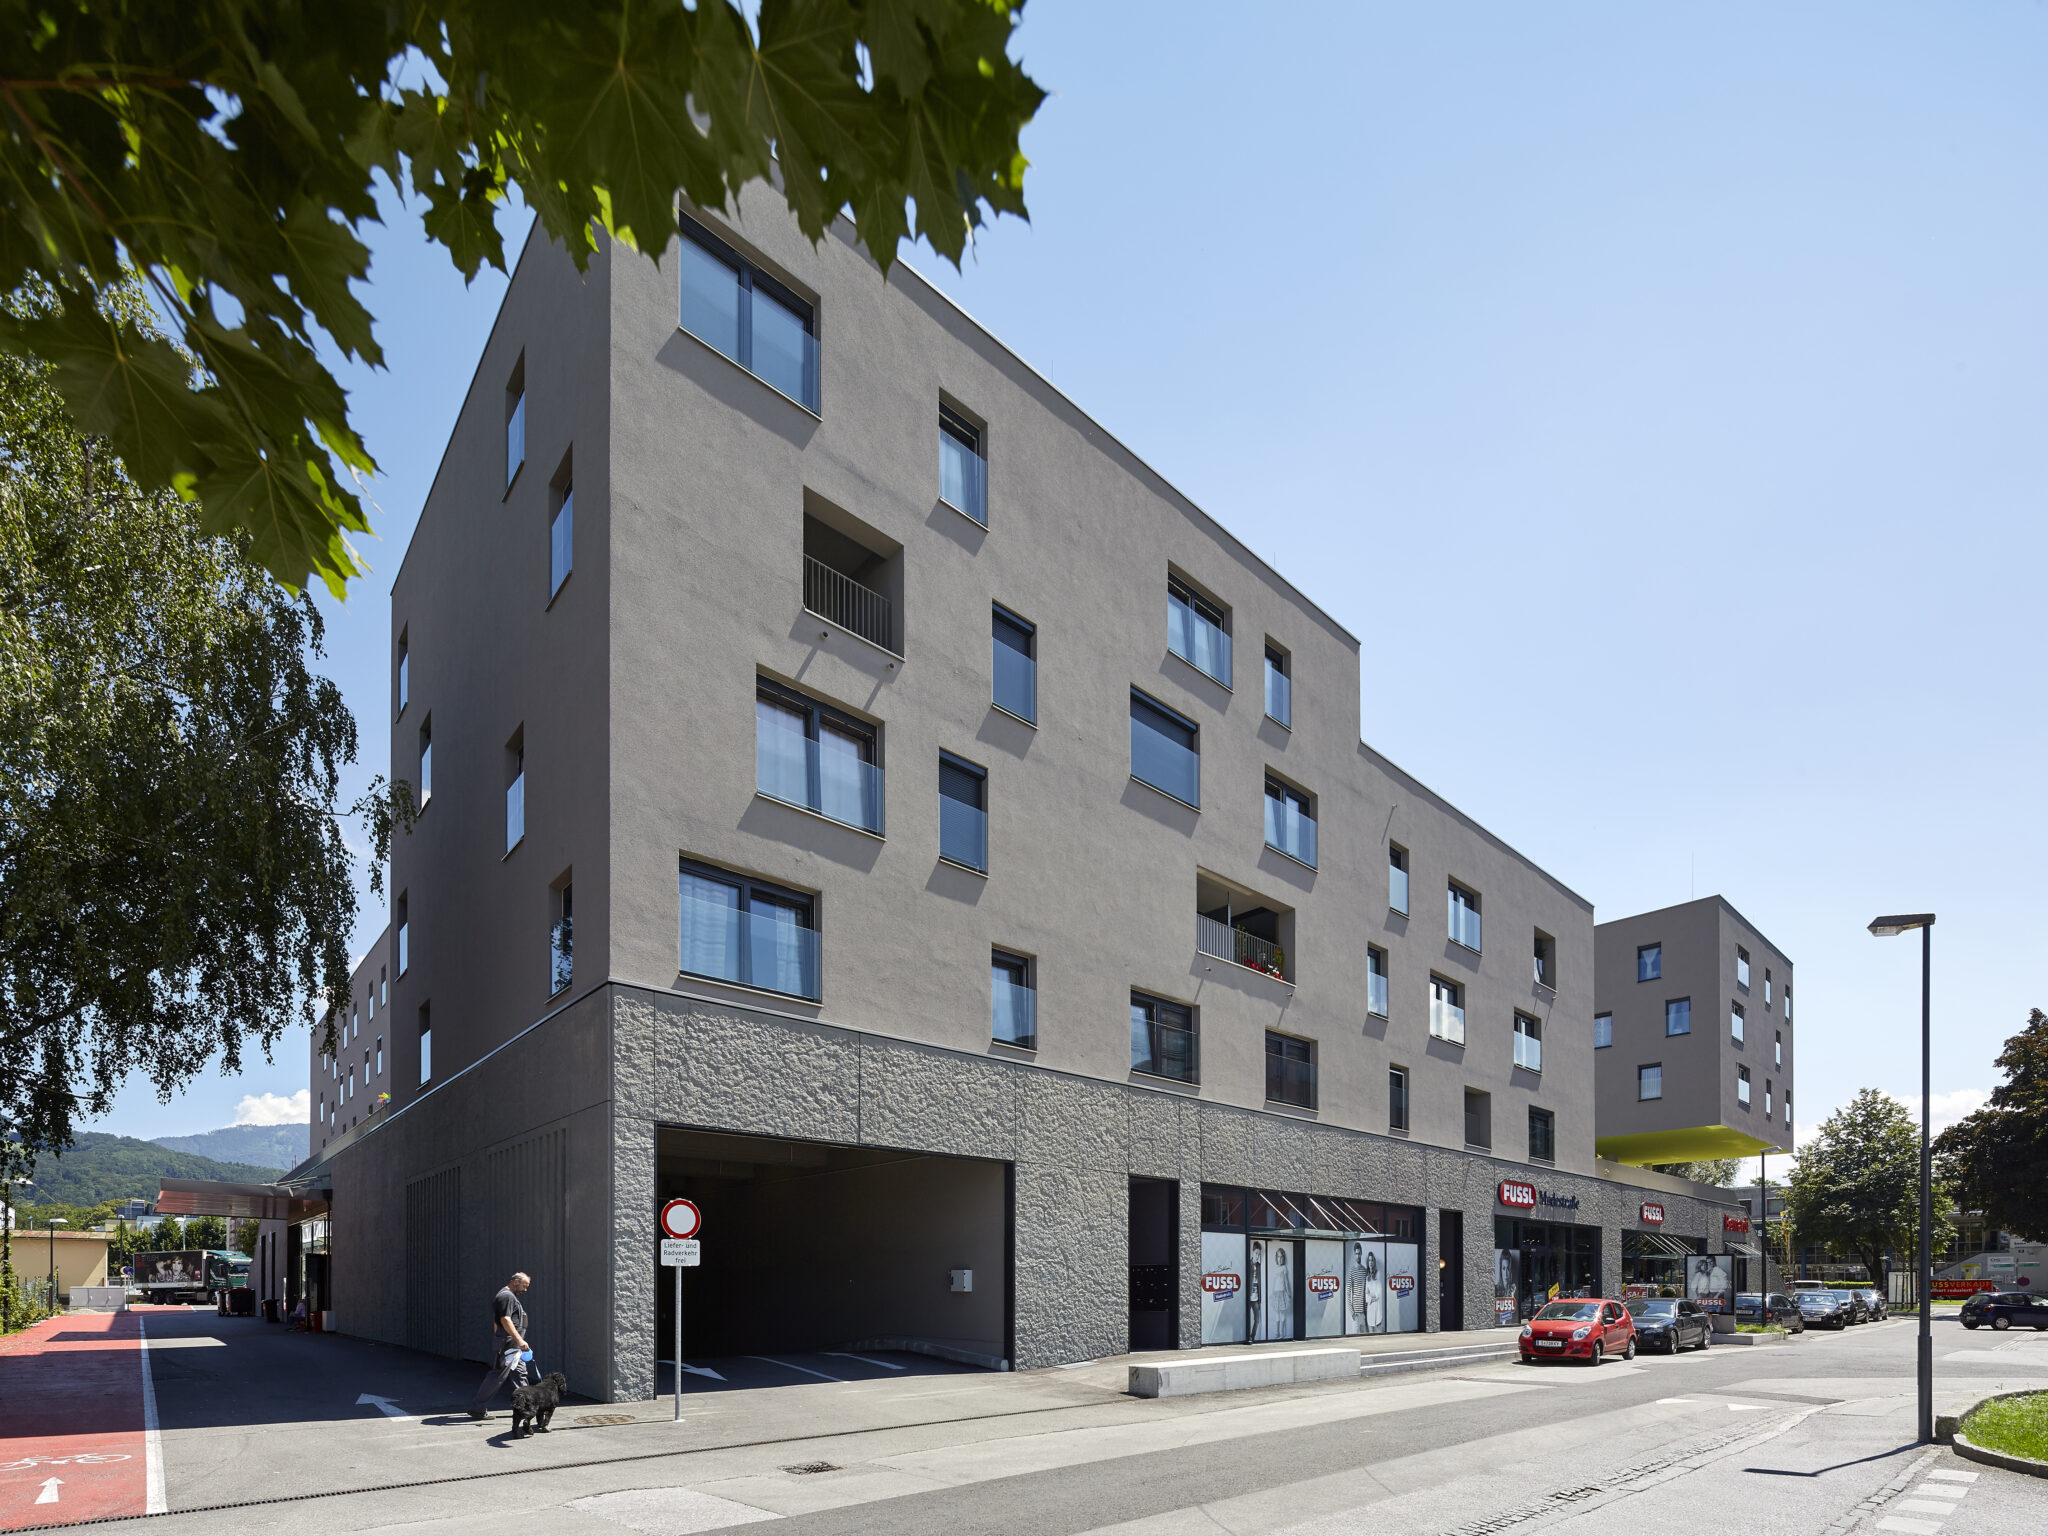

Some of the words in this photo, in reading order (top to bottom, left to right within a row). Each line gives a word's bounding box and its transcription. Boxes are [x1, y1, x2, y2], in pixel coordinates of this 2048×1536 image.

[1503, 1184, 1534, 1204] FUSSL
[1643, 1206, 1663, 1221] FUSSL
[1205, 1276, 1239, 1290] FUSSL
[1311, 1278, 1338, 1290] FUSSL
[1391, 1278, 1413, 1289] FUSSL
[1627, 1291, 1647, 1299] SALE
[1495, 1299, 1515, 1311] FUSSL
